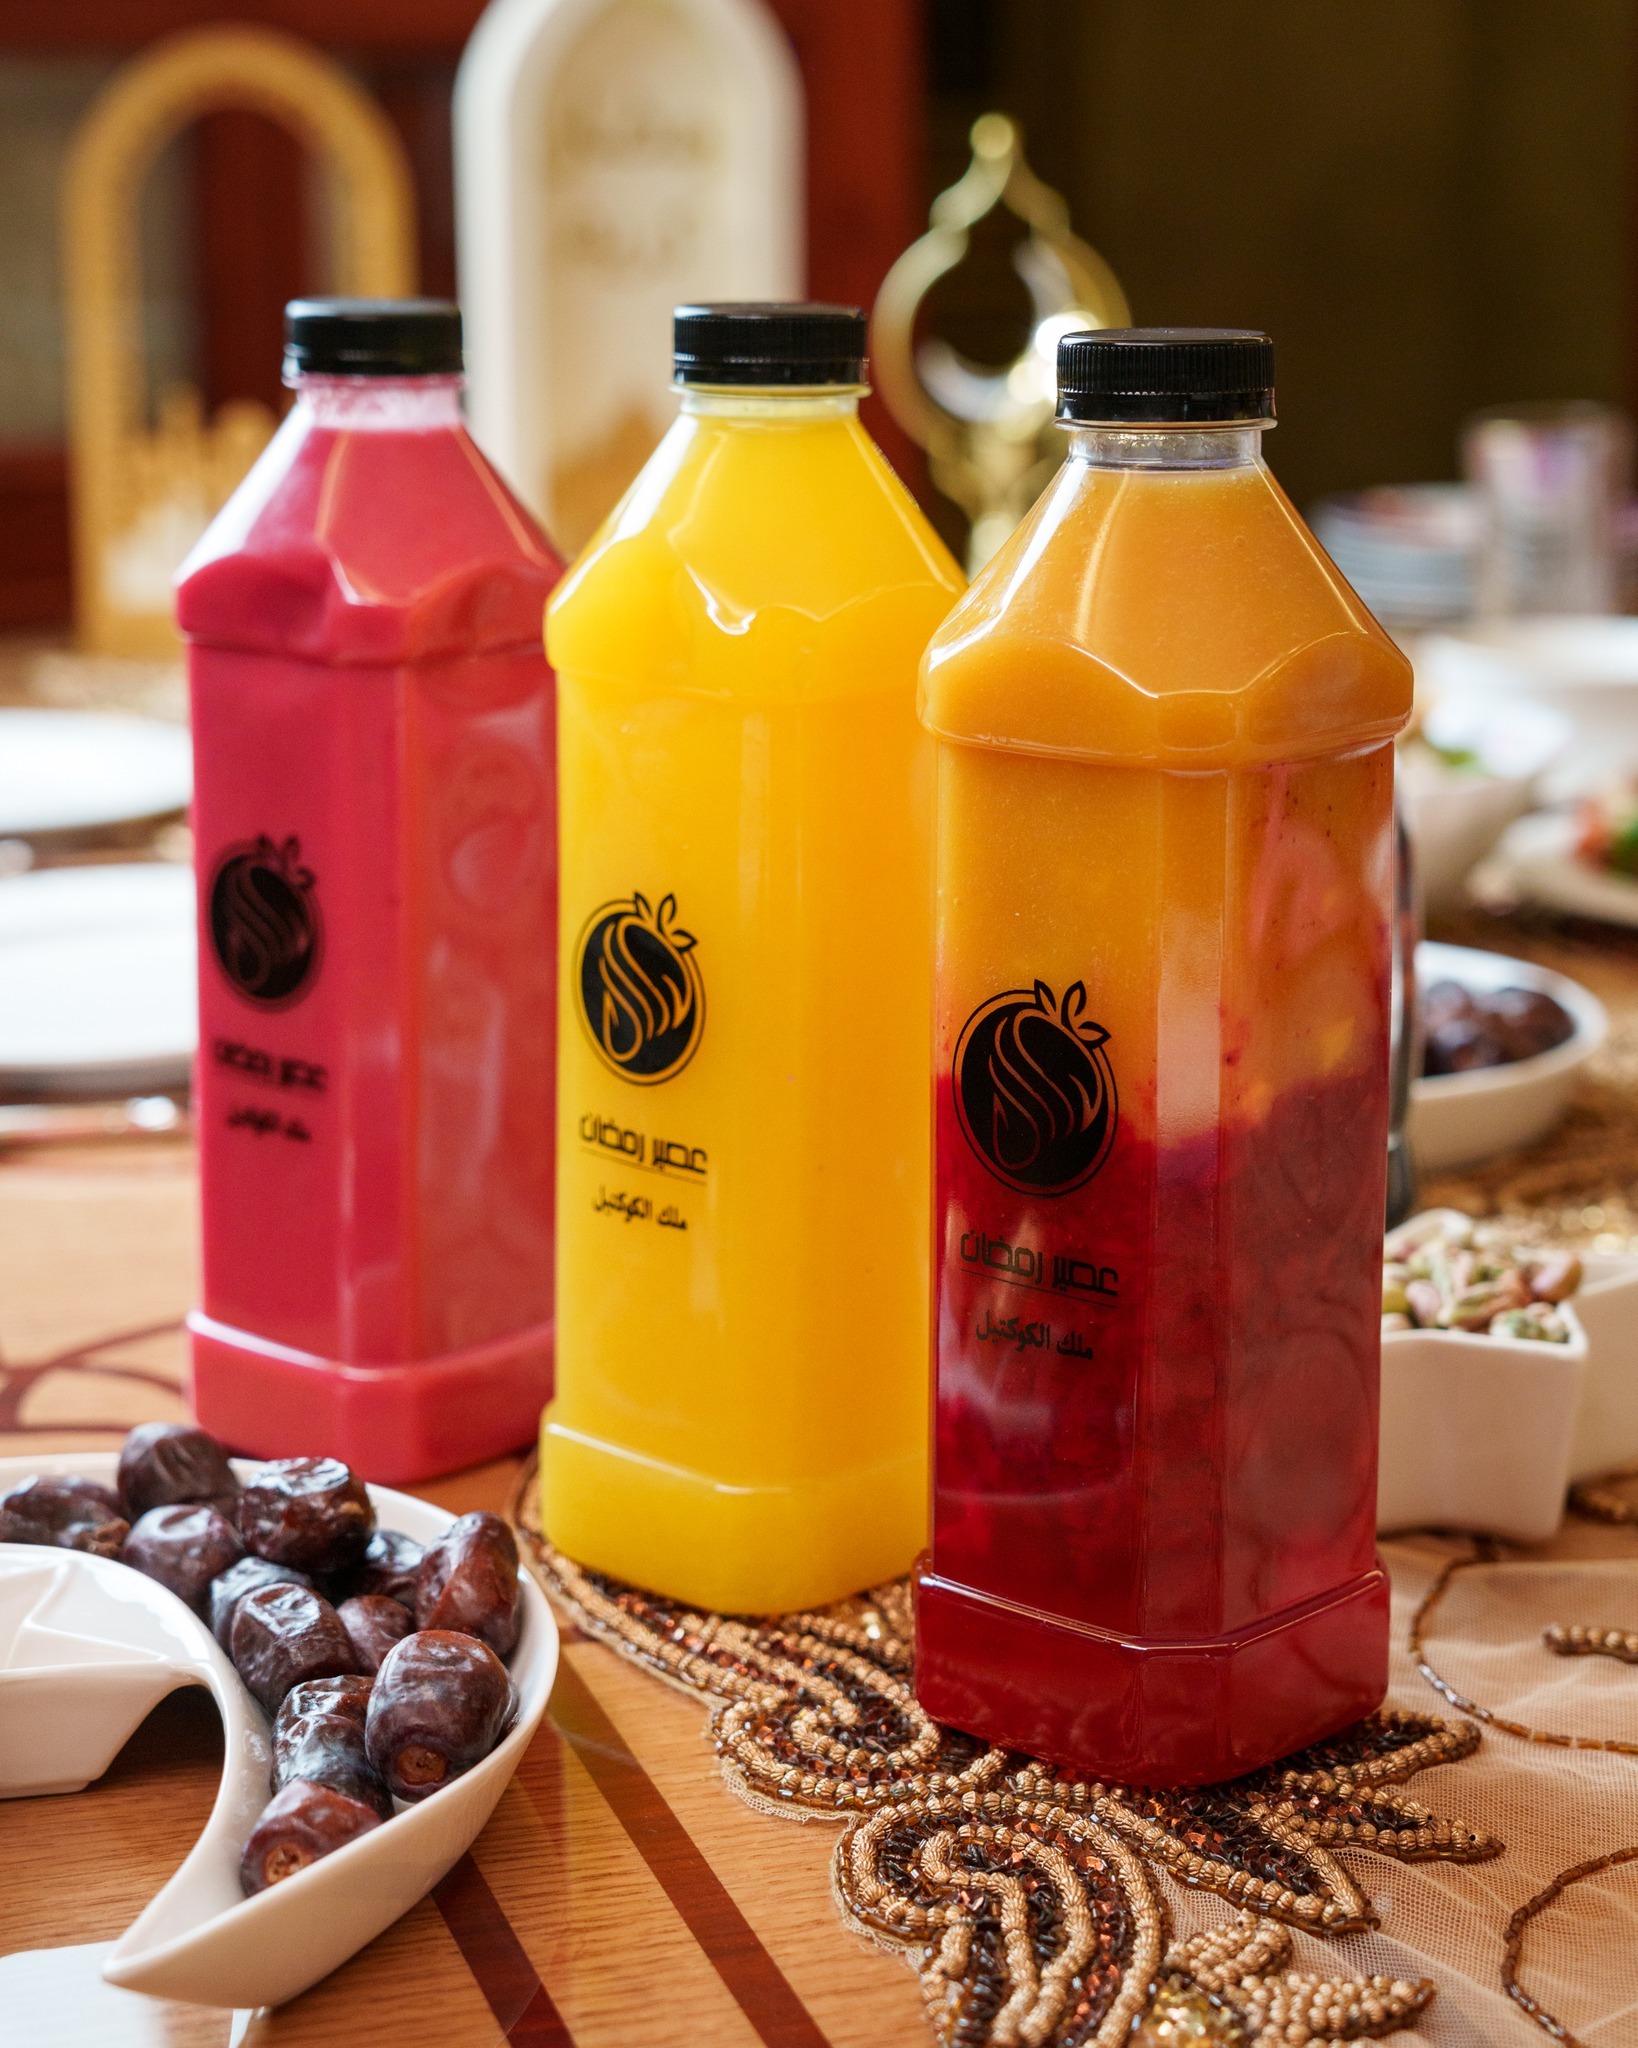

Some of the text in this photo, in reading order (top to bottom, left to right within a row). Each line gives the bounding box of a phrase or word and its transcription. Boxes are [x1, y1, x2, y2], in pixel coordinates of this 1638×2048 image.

[580, 1112, 707, 1174] عصير رمضان
[592, 1185, 688, 1230] ملك الكوكتيل
[960, 1229, 1118, 1296] عصير رمضان
[976, 1309, 1093, 1360] ملك الكوكتيل
